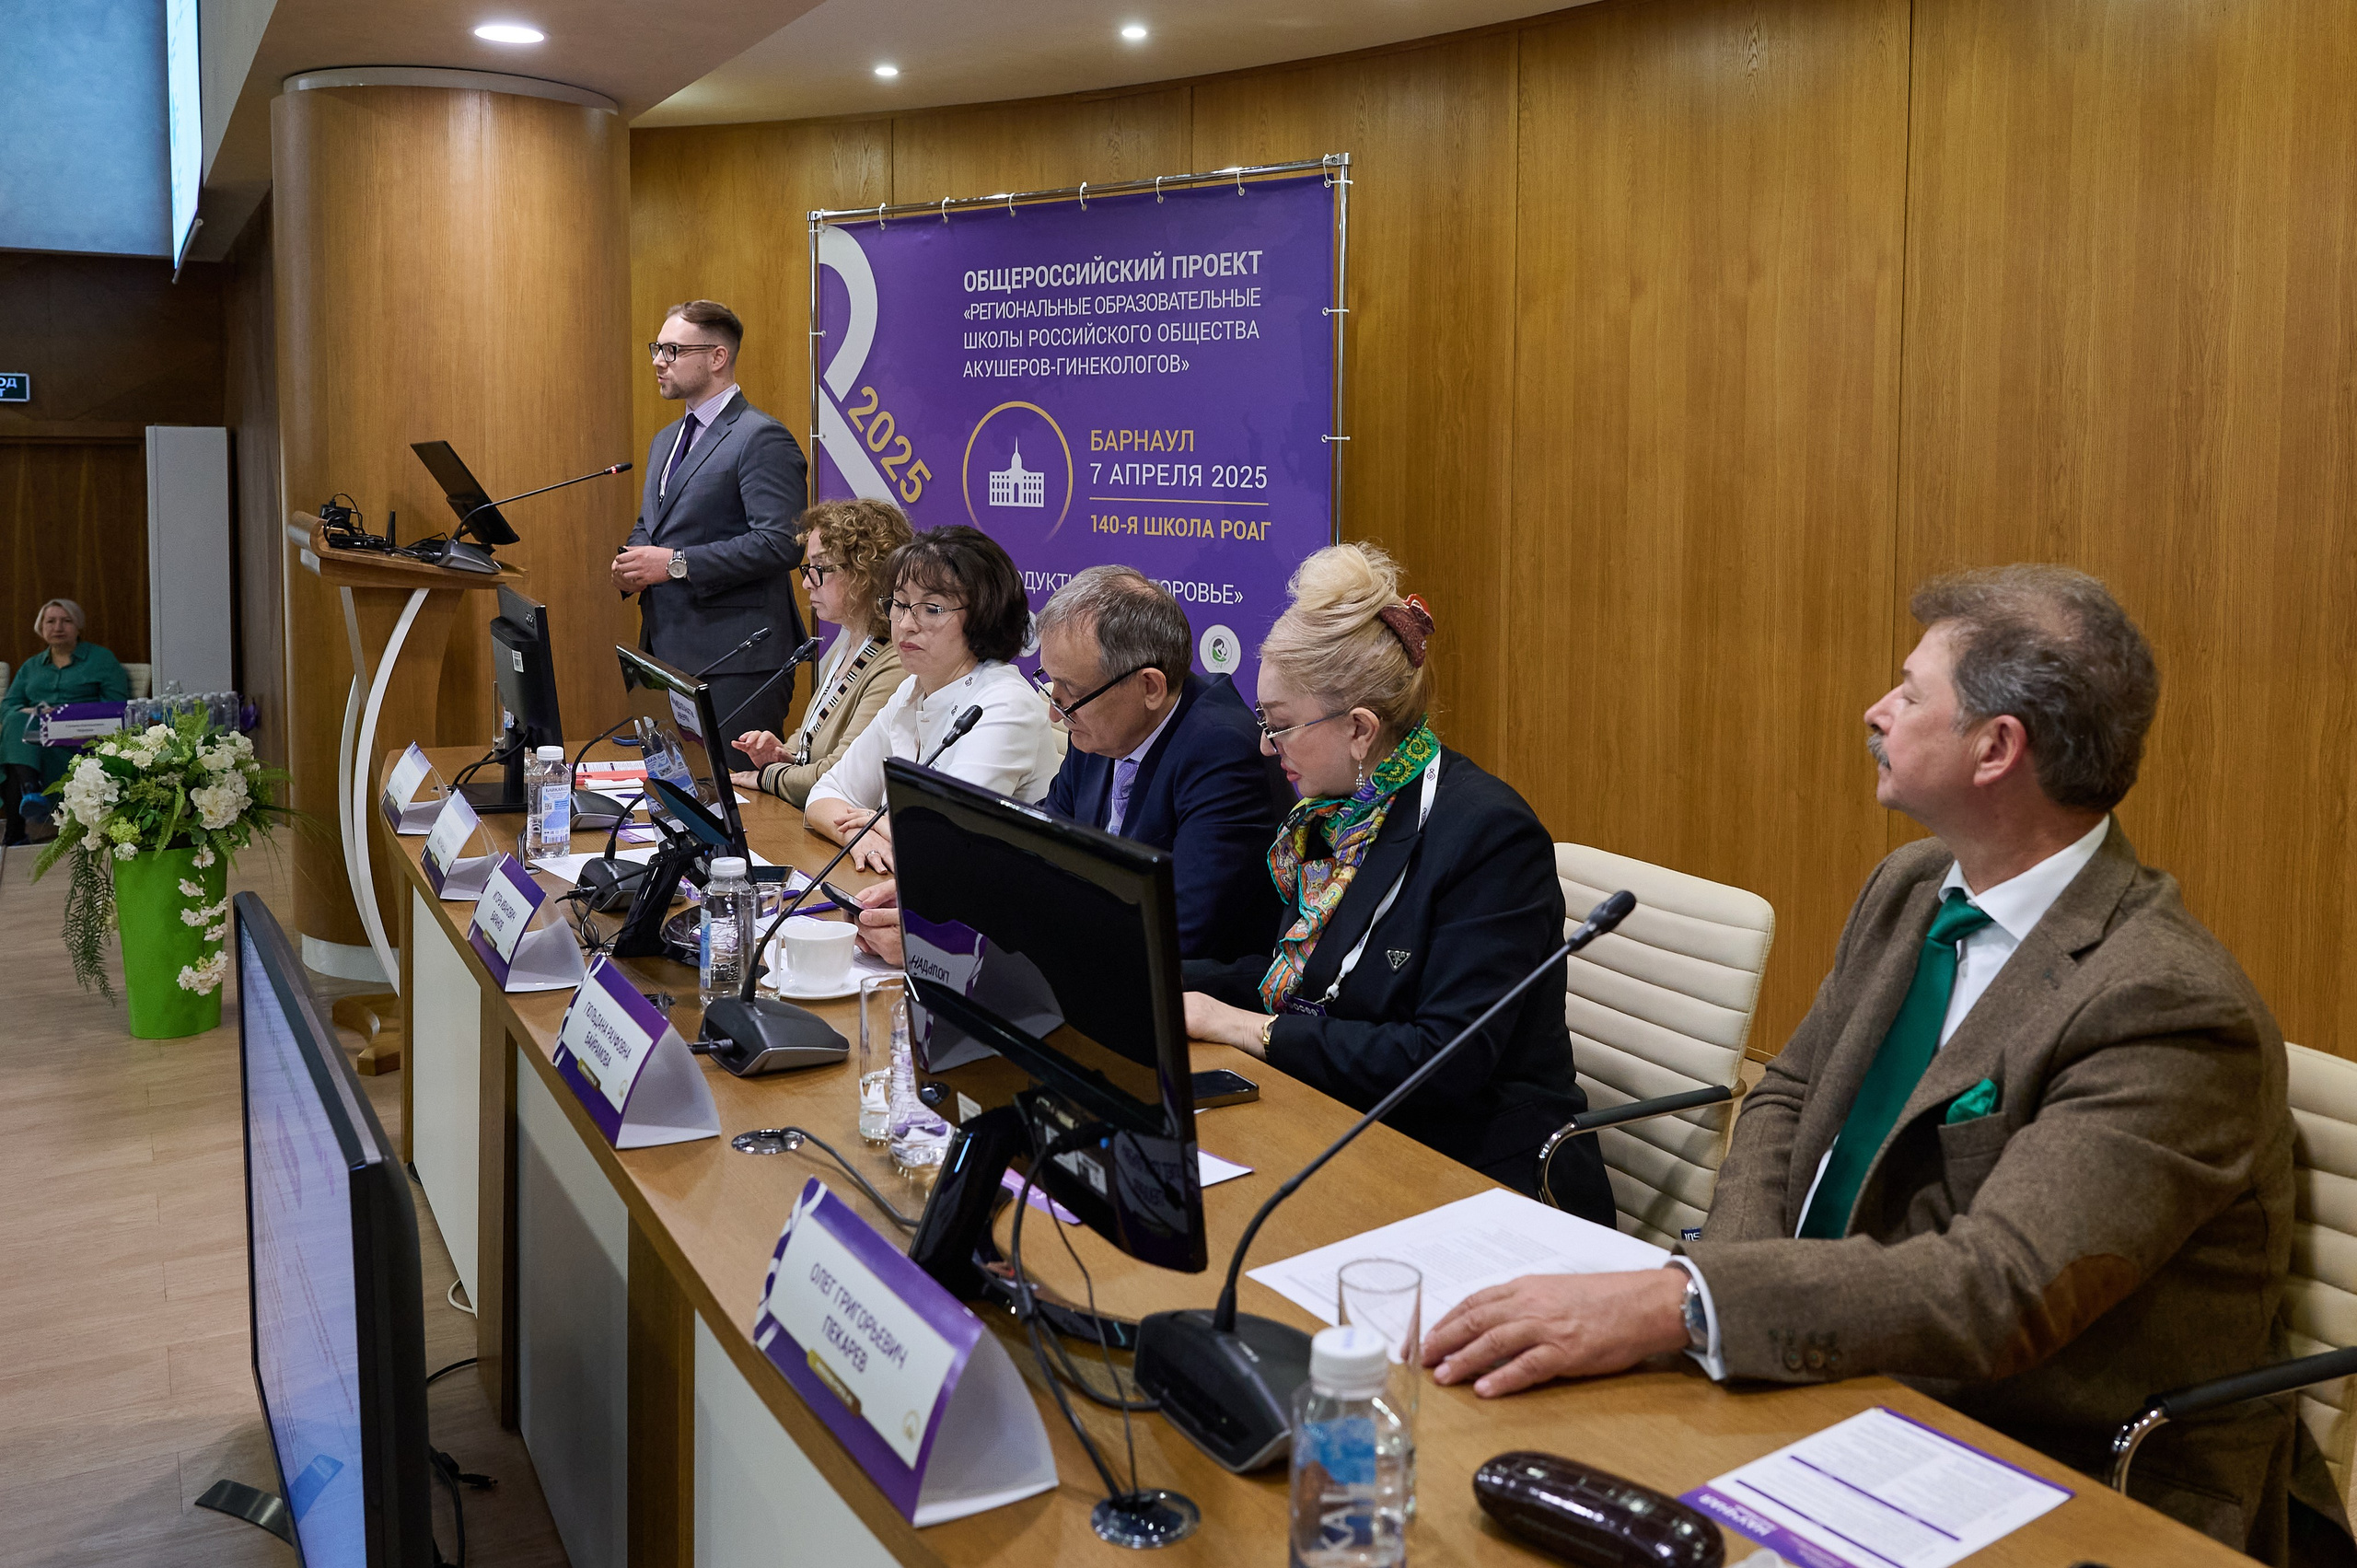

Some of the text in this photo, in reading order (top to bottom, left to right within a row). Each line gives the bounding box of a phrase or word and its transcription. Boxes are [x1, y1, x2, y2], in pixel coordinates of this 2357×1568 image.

[964, 250, 1263, 294] ОБЩЕРОССИЙСКИЙ ПРОЕКТ
[963, 287, 1261, 320] «РЕГИОНАЛЬНЫЕ ОБРАЗОВАТЕЛЬНЫЕ
[964, 319, 1260, 349] ШКОЛЫ РОССИЙСКОГО ОБЩЕСТВА
[963, 354, 1190, 377] АКУШЕРОВ-ГИНЕКОЛОГОВ»
[847, 386, 933, 504] 2025
[1090, 429, 1194, 452] БАРНАУЛ
[1089, 462, 1268, 489] 7 АПРЕЛЯ 2025
[1090, 514, 1271, 541] 140-Я ШКОЛА РОАГ
[1155, 578, 1244, 605] ОРОВЬЕ»
[584, 1029, 612, 1070] БАЙРАМОВА
[604, 1025, 633, 1063] РАУФОВНА
[809, 1261, 837, 1297] ОЛЕГ
[832, 1285, 909, 1370] ГРИГОРЬЕВИЧ
[821, 1315, 869, 1374] ПЕКАРЕВ
